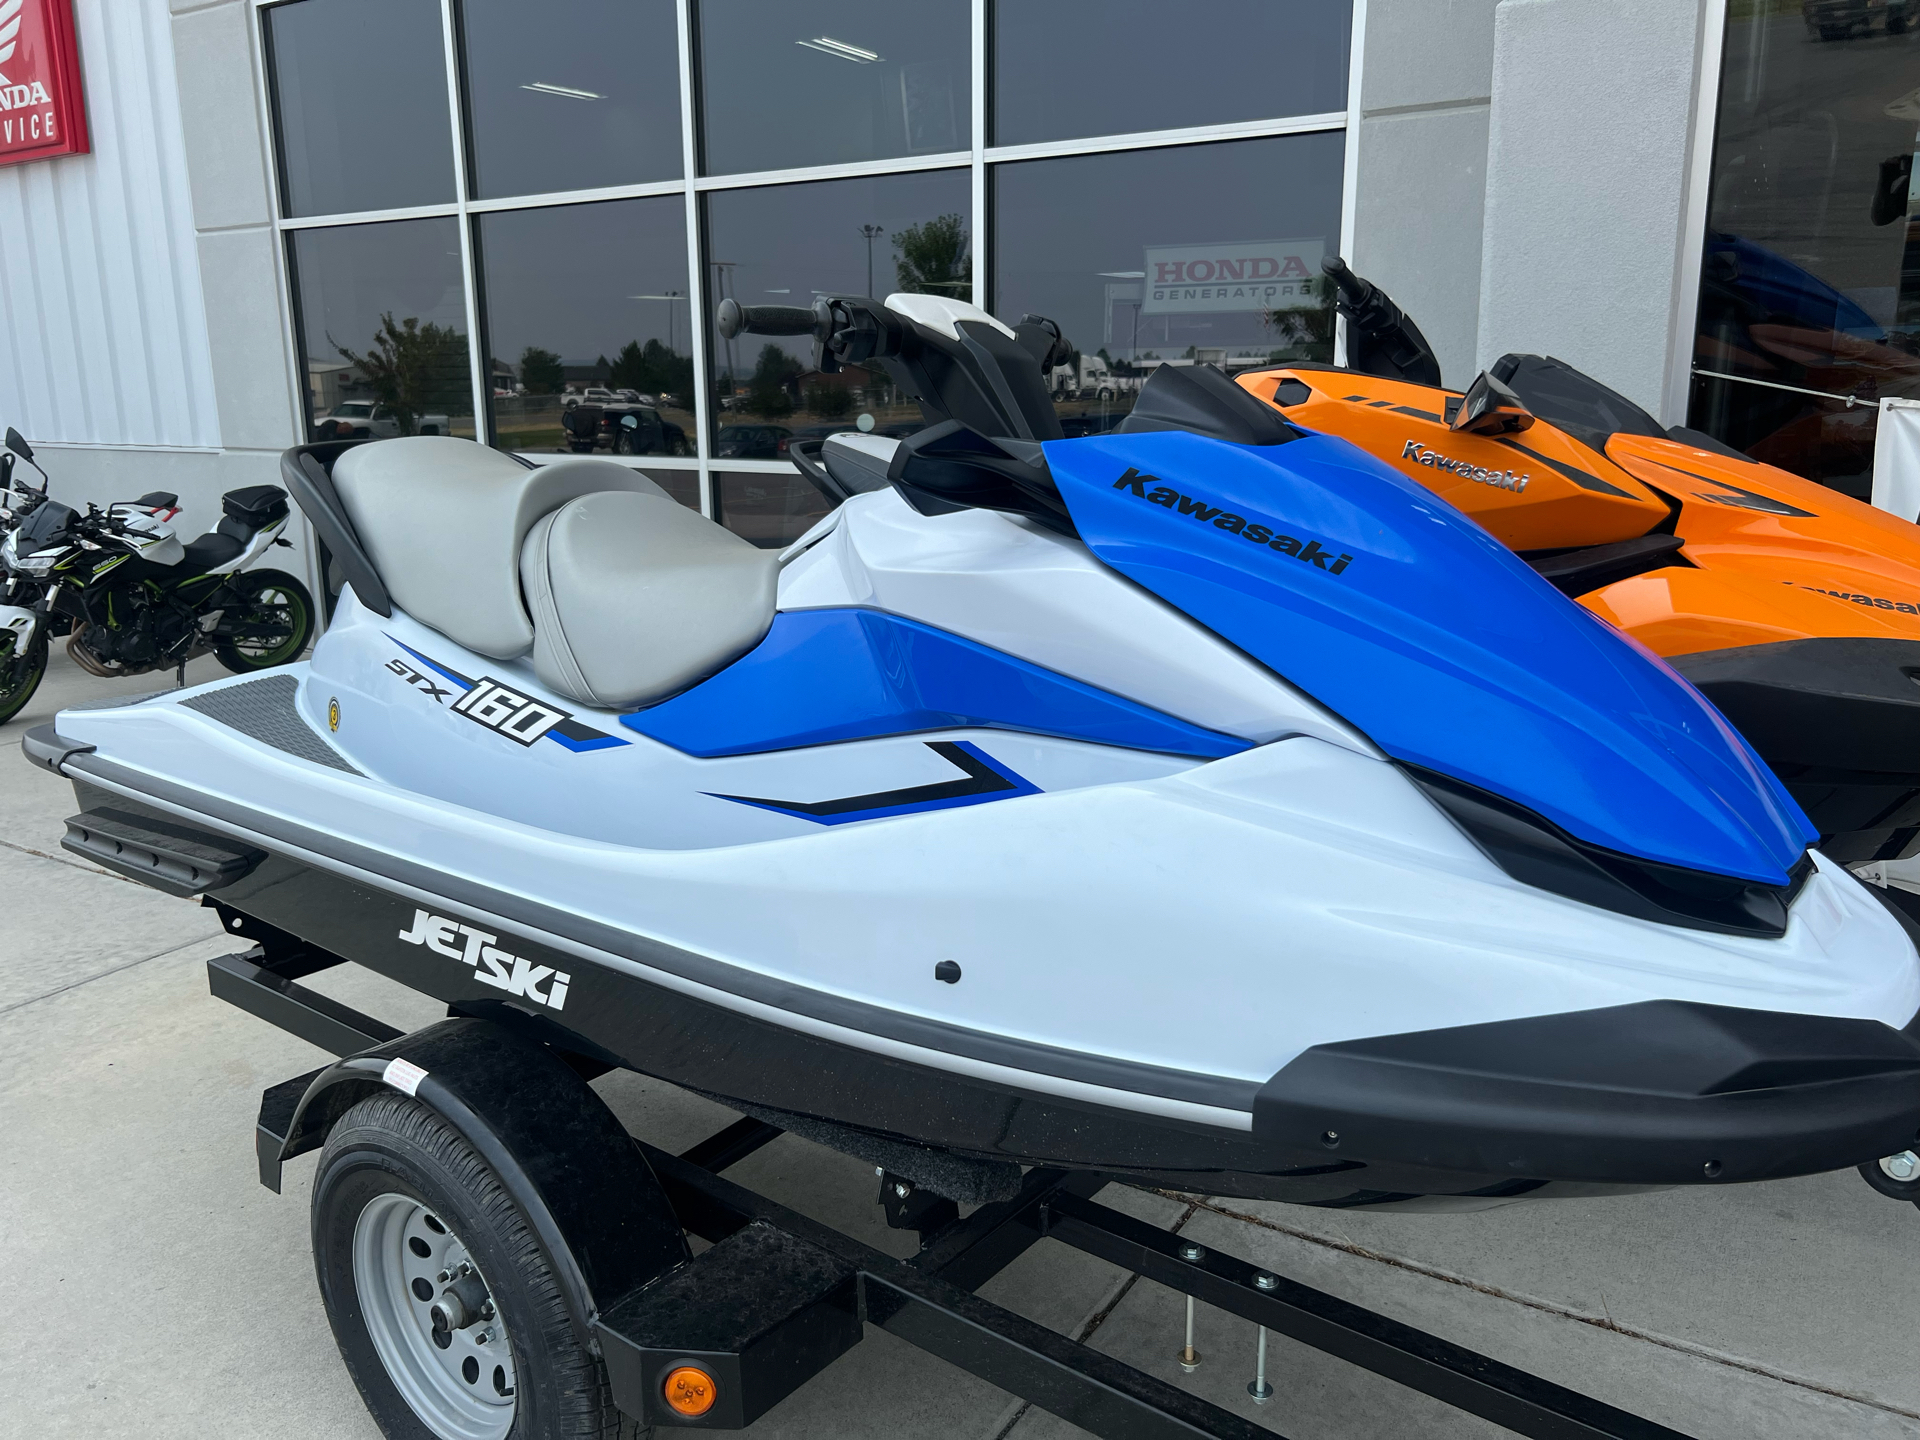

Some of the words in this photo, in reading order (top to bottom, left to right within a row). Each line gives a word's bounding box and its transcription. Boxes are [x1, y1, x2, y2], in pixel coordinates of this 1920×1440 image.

[1153, 284, 1312, 301] GENERATORS
[1154, 256, 1312, 283] HONDA
[1402, 439, 1529, 494] Kawasaki
[1112, 466, 1354, 576] Kawasaki
[384, 658, 454, 705] STX
[453, 677, 570, 745] 160
